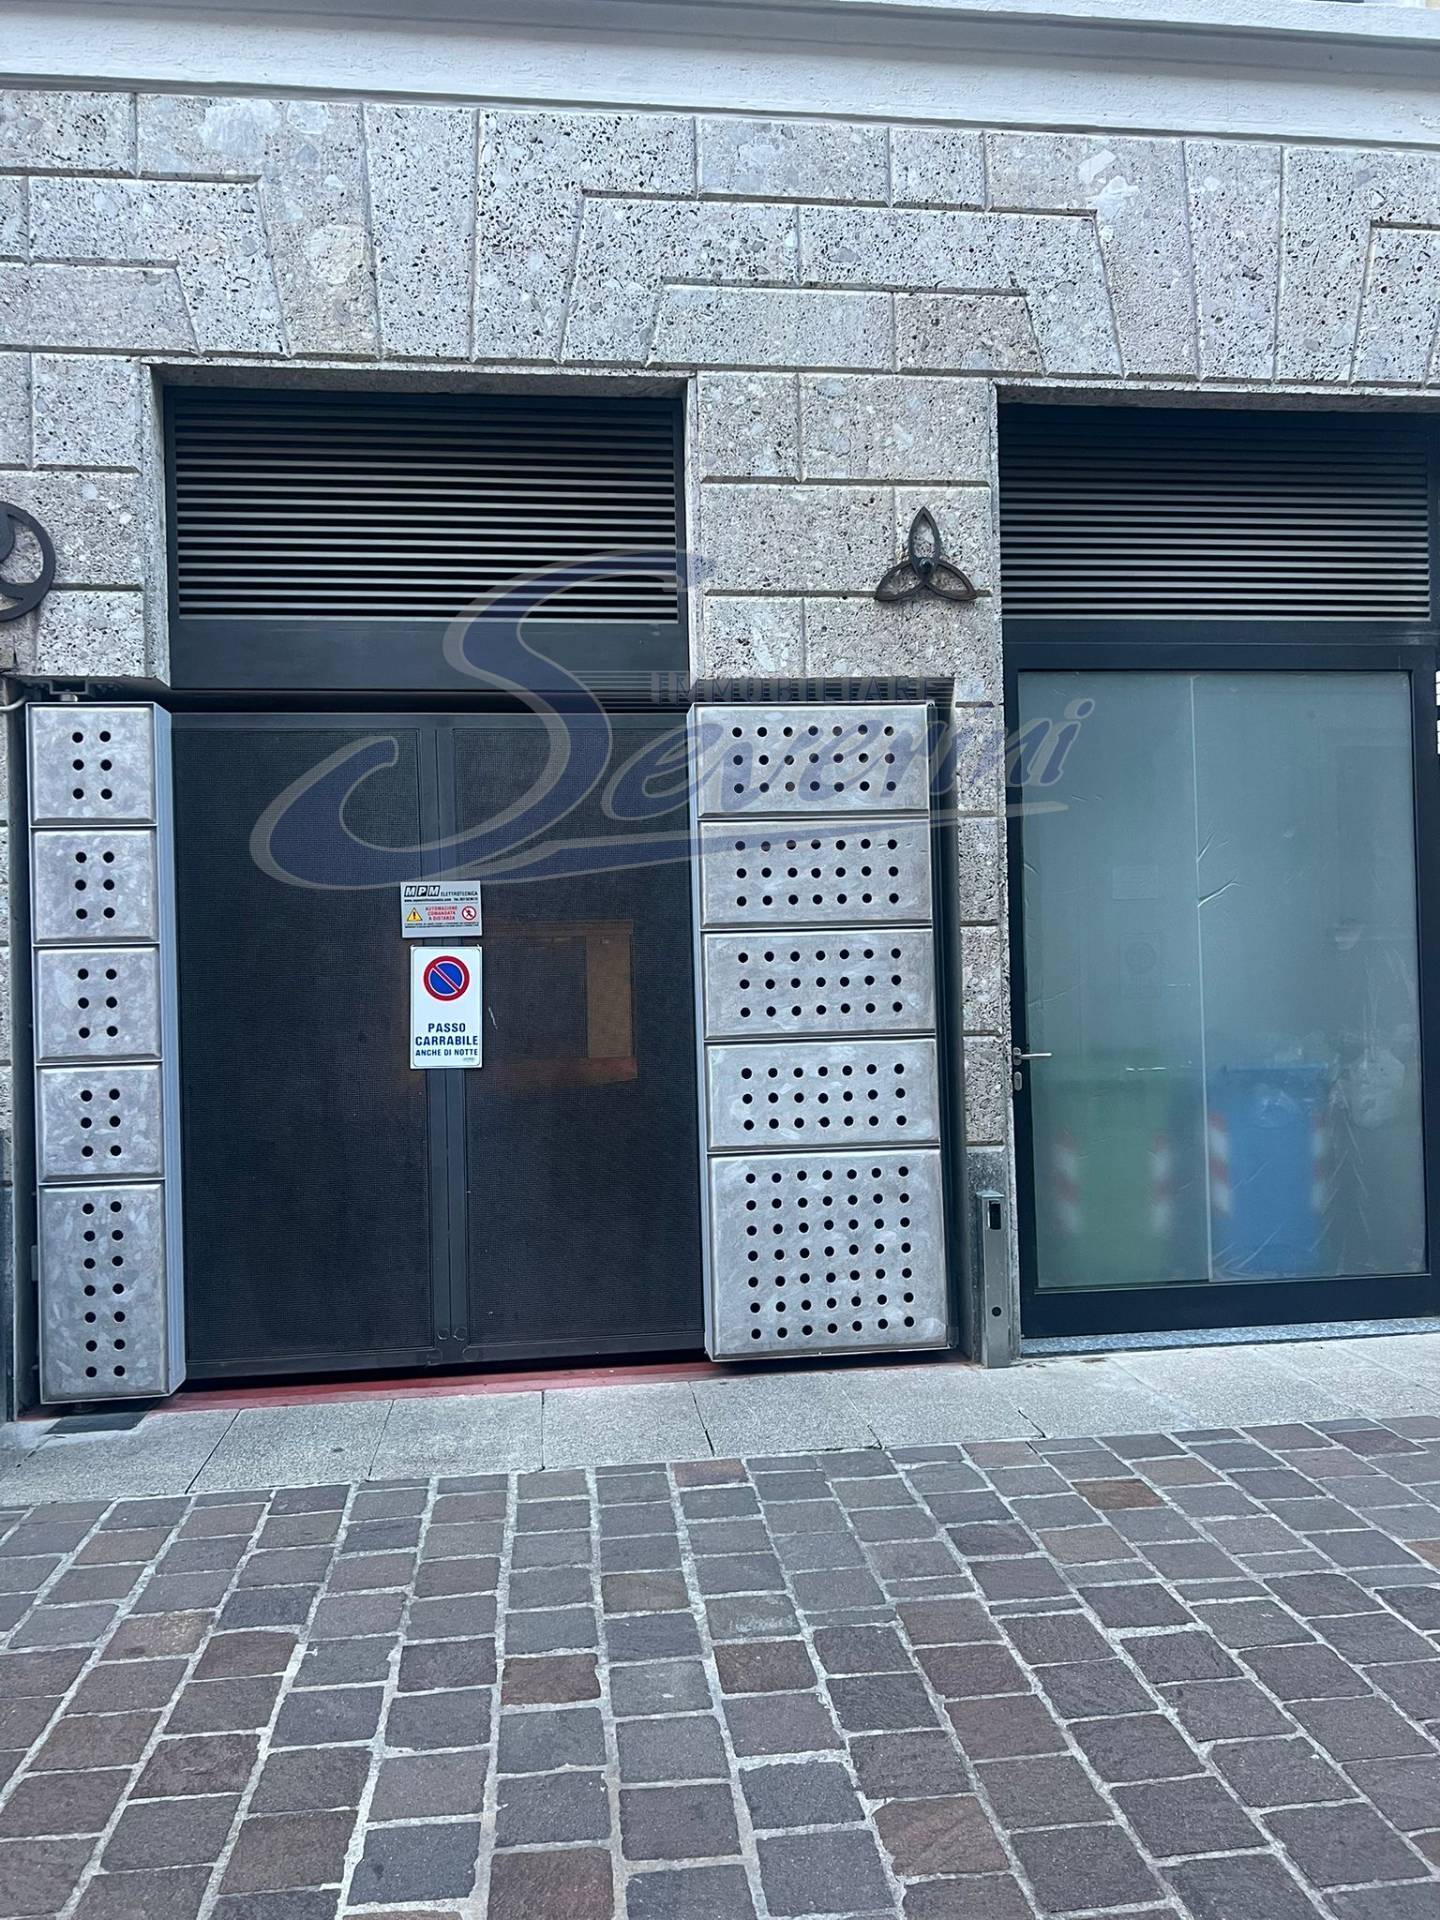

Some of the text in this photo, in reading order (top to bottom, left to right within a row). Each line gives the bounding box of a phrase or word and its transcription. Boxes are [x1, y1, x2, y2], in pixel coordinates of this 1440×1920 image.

[404, 885, 440, 897] MPM
[428, 1022, 466, 1033] PASSO
[415, 1035, 478, 1046] CARRABILE
[454, 1048, 478, 1056] NOTTE
